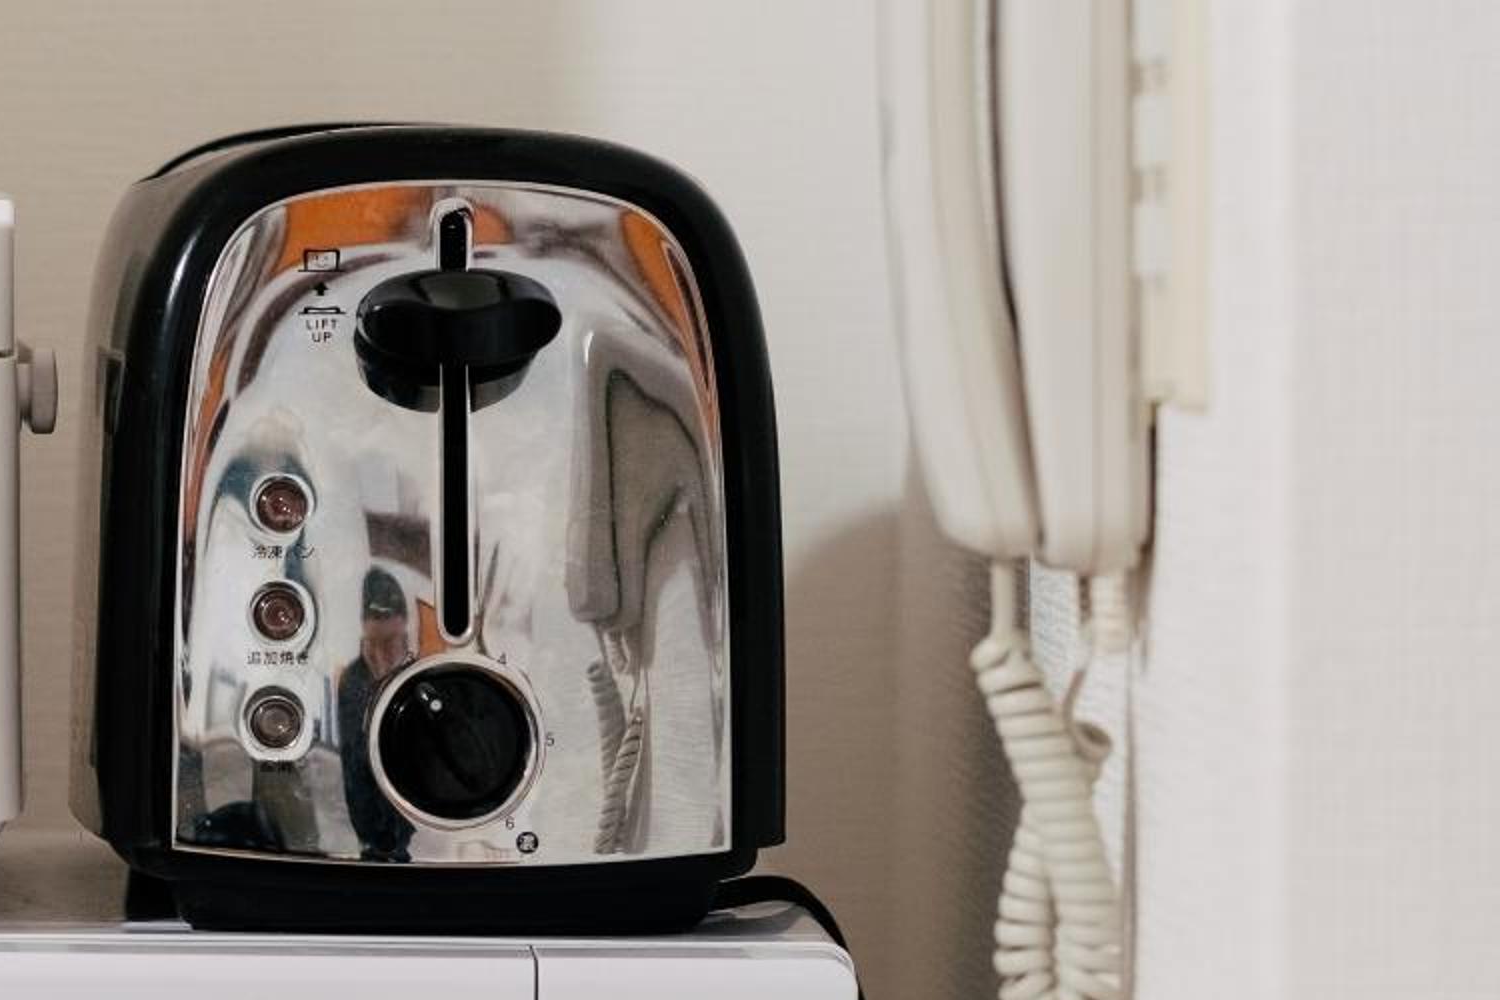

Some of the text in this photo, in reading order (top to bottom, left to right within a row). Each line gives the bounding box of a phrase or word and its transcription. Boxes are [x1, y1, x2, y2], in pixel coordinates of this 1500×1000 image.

[305, 318, 337, 330] LIFT
[311, 331, 332, 343] UP
[545, 732, 555, 746] 5
[505, 815, 515, 830] 6
